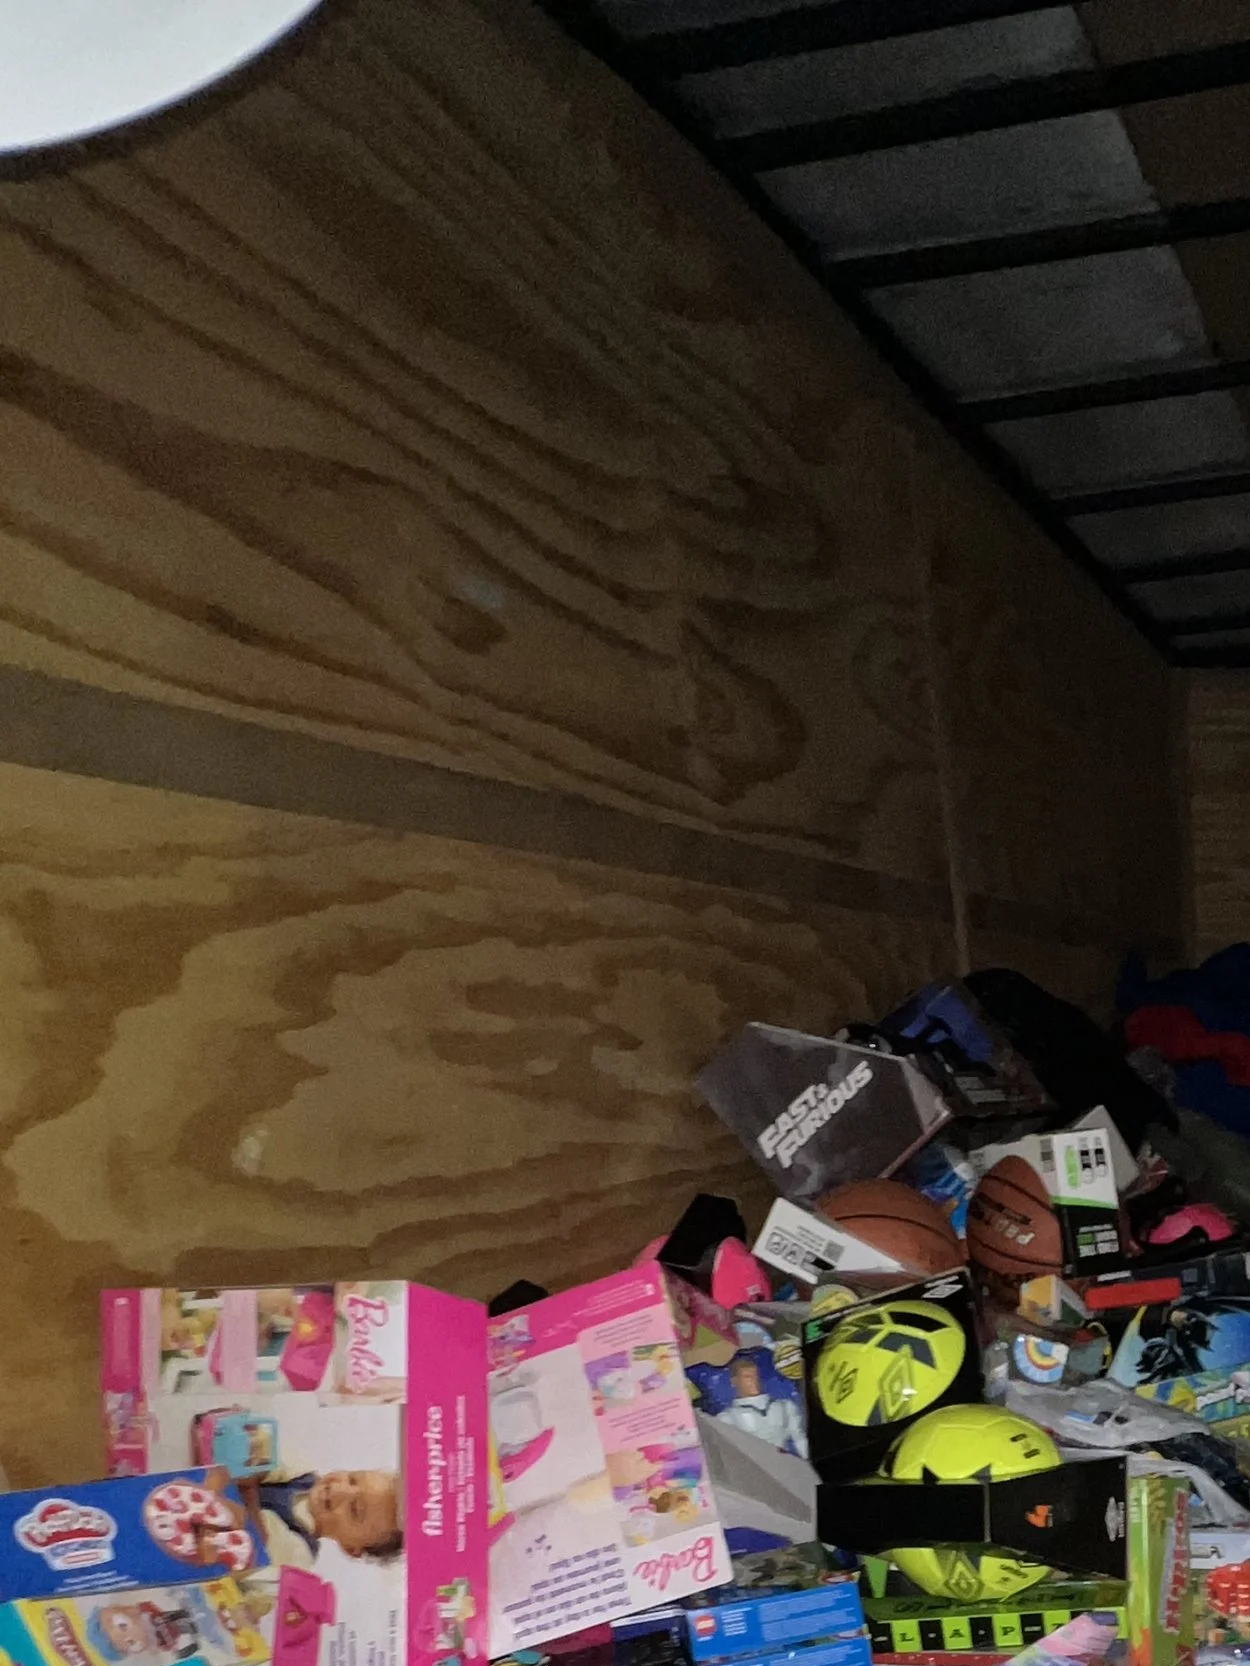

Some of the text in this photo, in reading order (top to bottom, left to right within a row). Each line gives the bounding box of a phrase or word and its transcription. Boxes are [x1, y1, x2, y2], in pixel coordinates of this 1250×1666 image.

[758, 1083, 822, 1160] FAST
[777, 1060, 874, 1168] FURIOUS
[347, 1296, 389, 1392] Barbie
[634, 1535, 716, 1592] Barbie
